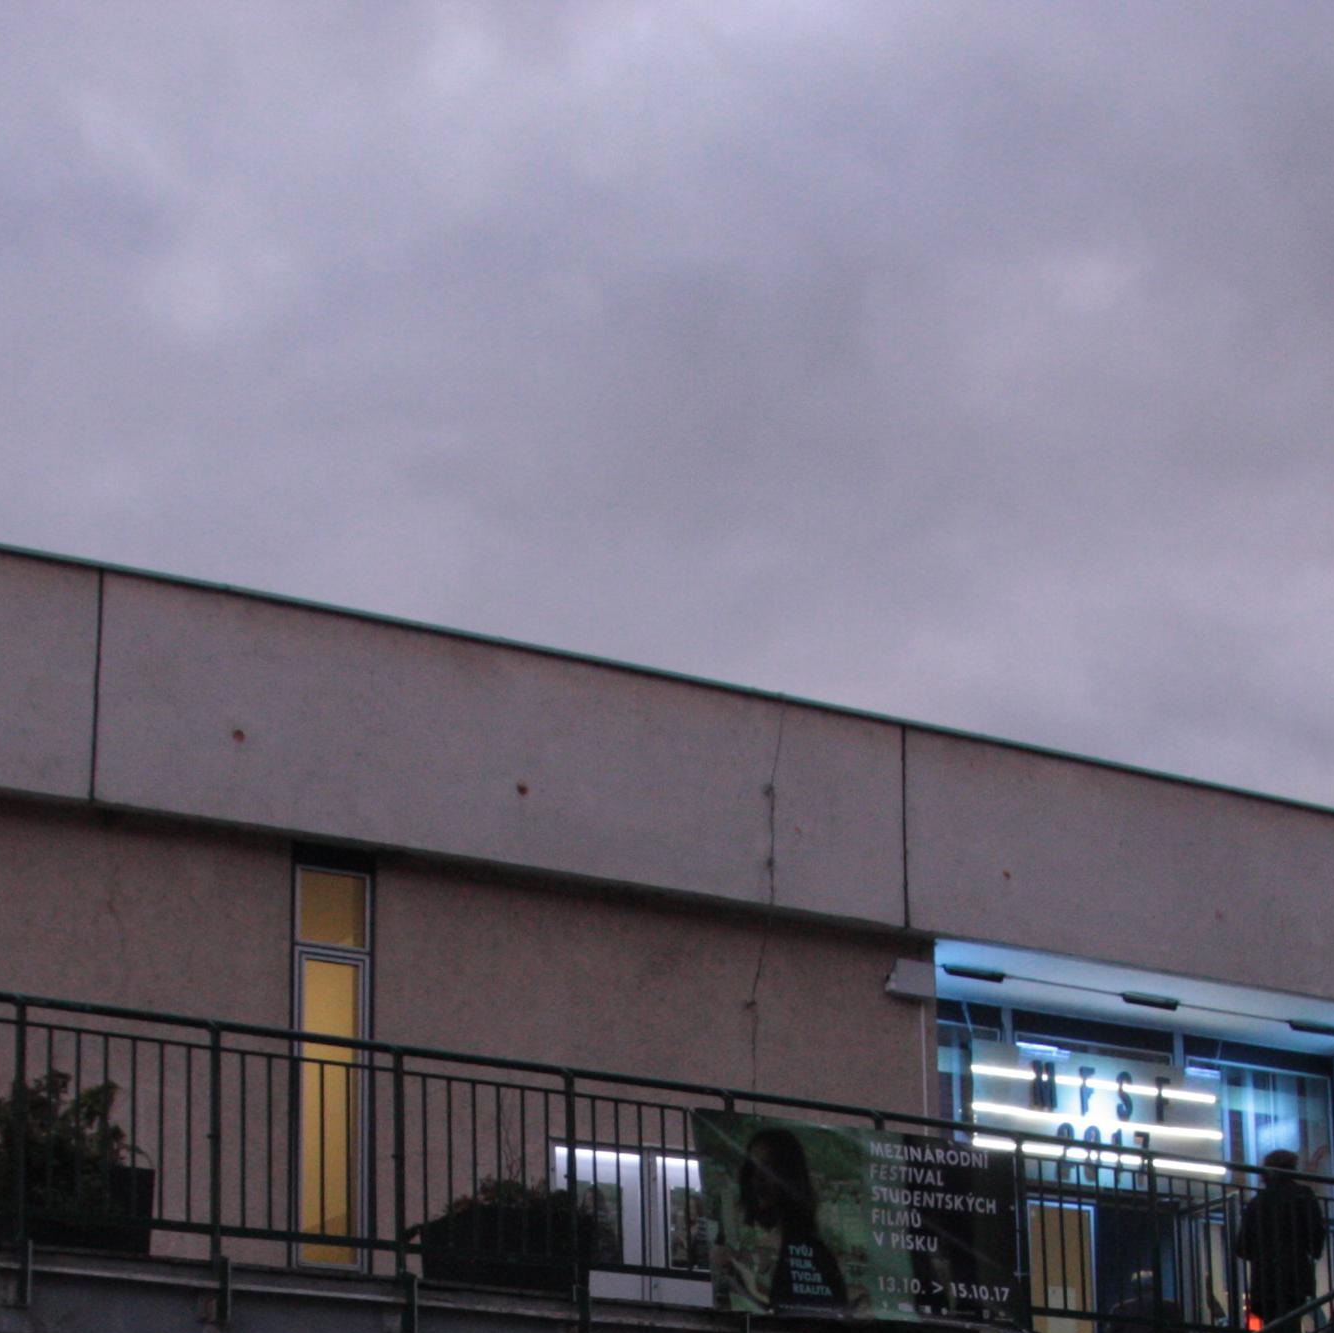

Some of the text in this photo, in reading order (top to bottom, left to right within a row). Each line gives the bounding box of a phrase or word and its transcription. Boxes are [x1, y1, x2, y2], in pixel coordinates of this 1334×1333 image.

[1030, 1058, 1170, 1124] MFSF
[869, 1141, 988, 1169] MEZINÁRODNÍ
[1057, 1122, 1150, 1187] 2017
[870, 1163, 944, 1187] FESTIVAL
[871, 1186, 997, 1214] STUDENTSKÝCH
[871, 1208, 922, 1228] FILMŮ
[873, 1230, 938, 1252] V PÍSKU
[878, 1276, 926, 1295] 13.10.
[950, 1282, 1010, 1302] 15.10.17
